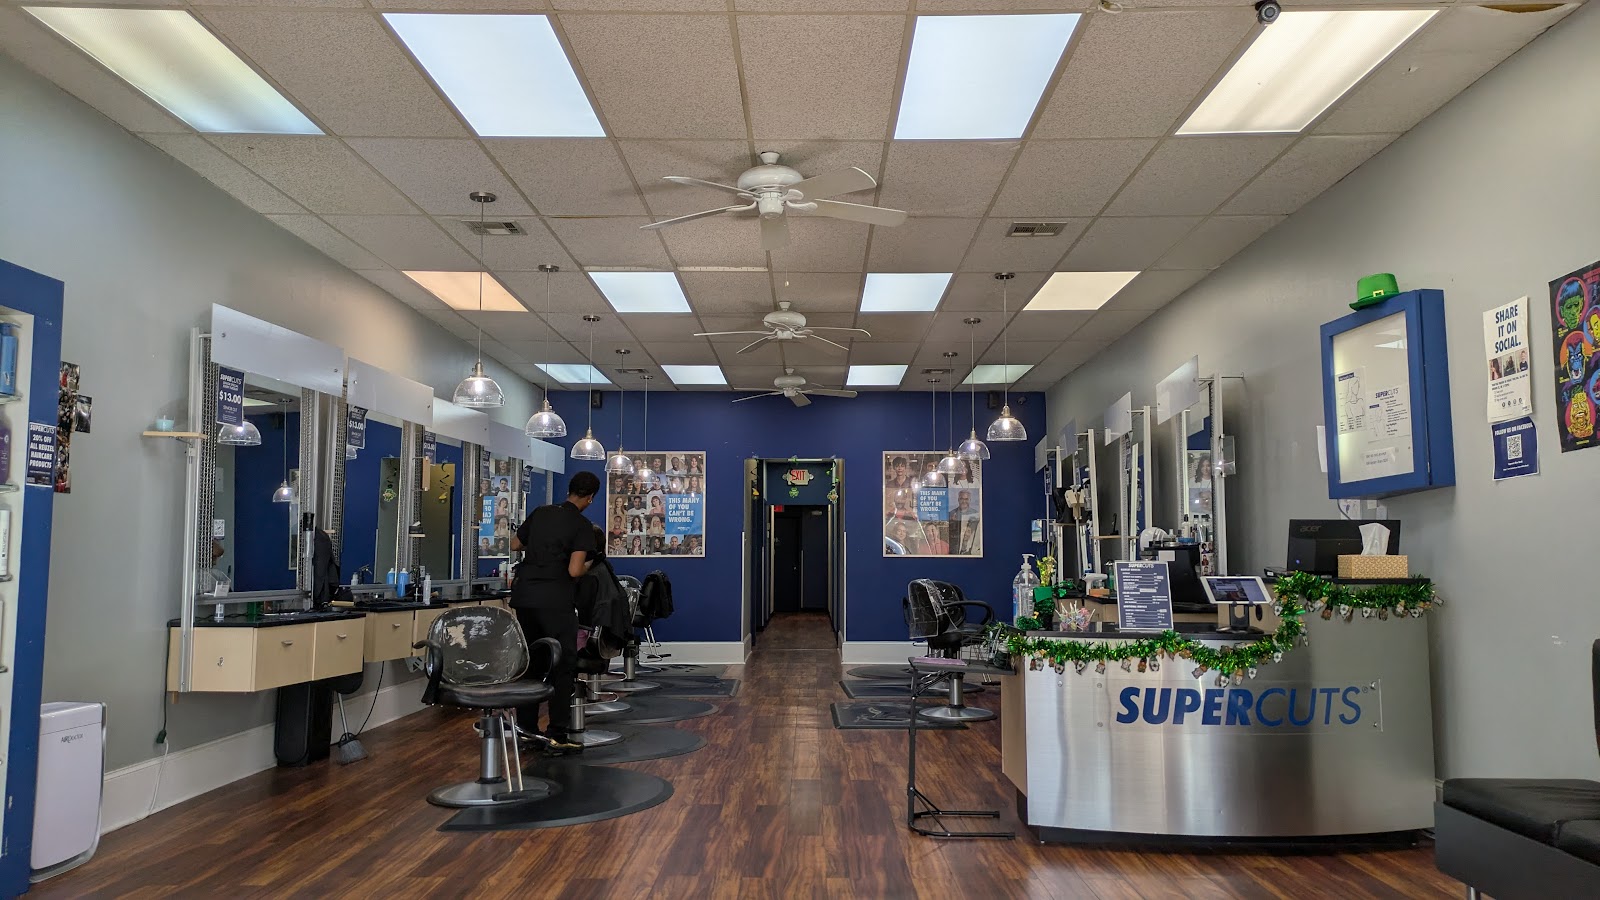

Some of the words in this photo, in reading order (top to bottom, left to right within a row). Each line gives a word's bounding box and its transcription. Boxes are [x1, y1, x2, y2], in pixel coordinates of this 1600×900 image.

[1495, 305, 1518, 324] SHARE
[1498, 325, 1505, 338] IT
[1506, 320, 1517, 335] ON
[1494, 335, 1521, 354] SOCIAL.
[219, 390, 241, 404] $13.00
[1375, 387, 1399, 399] SUPERCUTS
[30, 425, 54, 434] SUPERCUTS
[30, 442, 38, 450] ALL
[31, 451, 52, 460] HAIRCARE
[30, 460, 52, 469] PRODUCTS
[791, 470, 806, 481] EXIT
